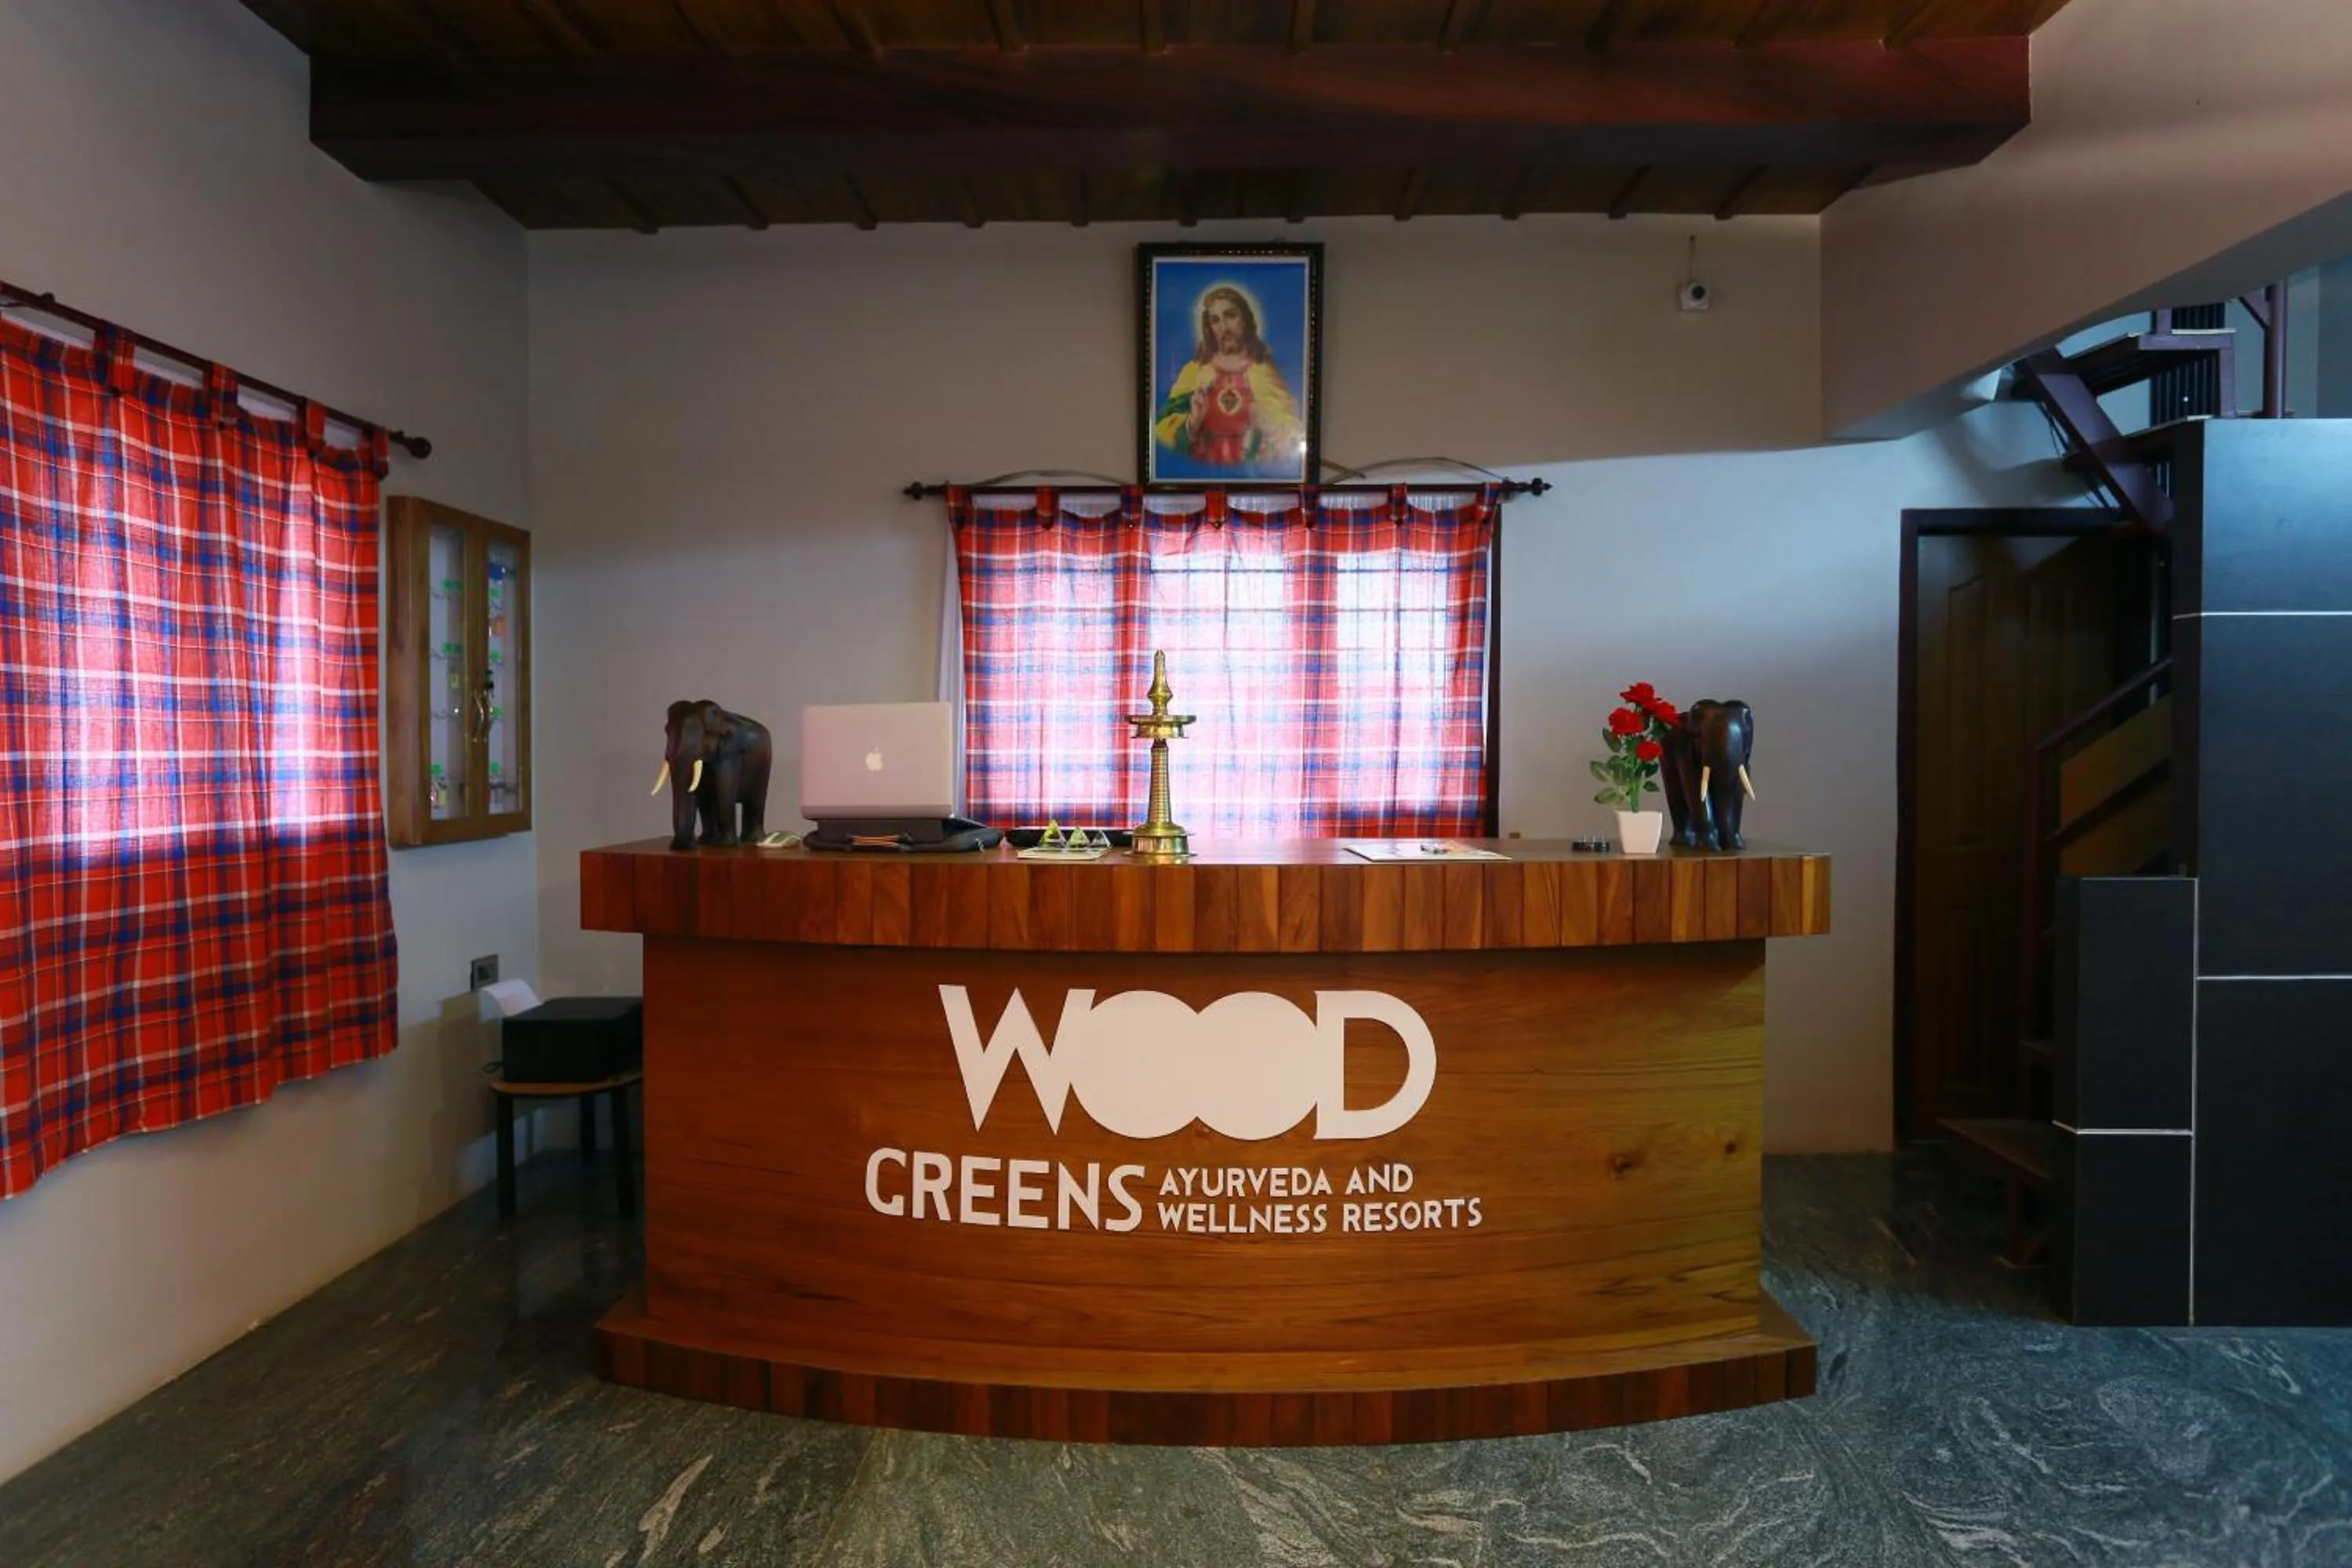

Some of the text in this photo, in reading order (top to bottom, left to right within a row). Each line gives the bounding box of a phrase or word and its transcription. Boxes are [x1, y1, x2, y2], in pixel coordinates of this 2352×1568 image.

[938, 984, 1437, 1141] WOOD
[865, 1147, 1145, 1232] GREENS
[1160, 1163, 1414, 1197] AYURVEDA AND
[1157, 1197, 1482, 1233] WELLNESS RESORTS
